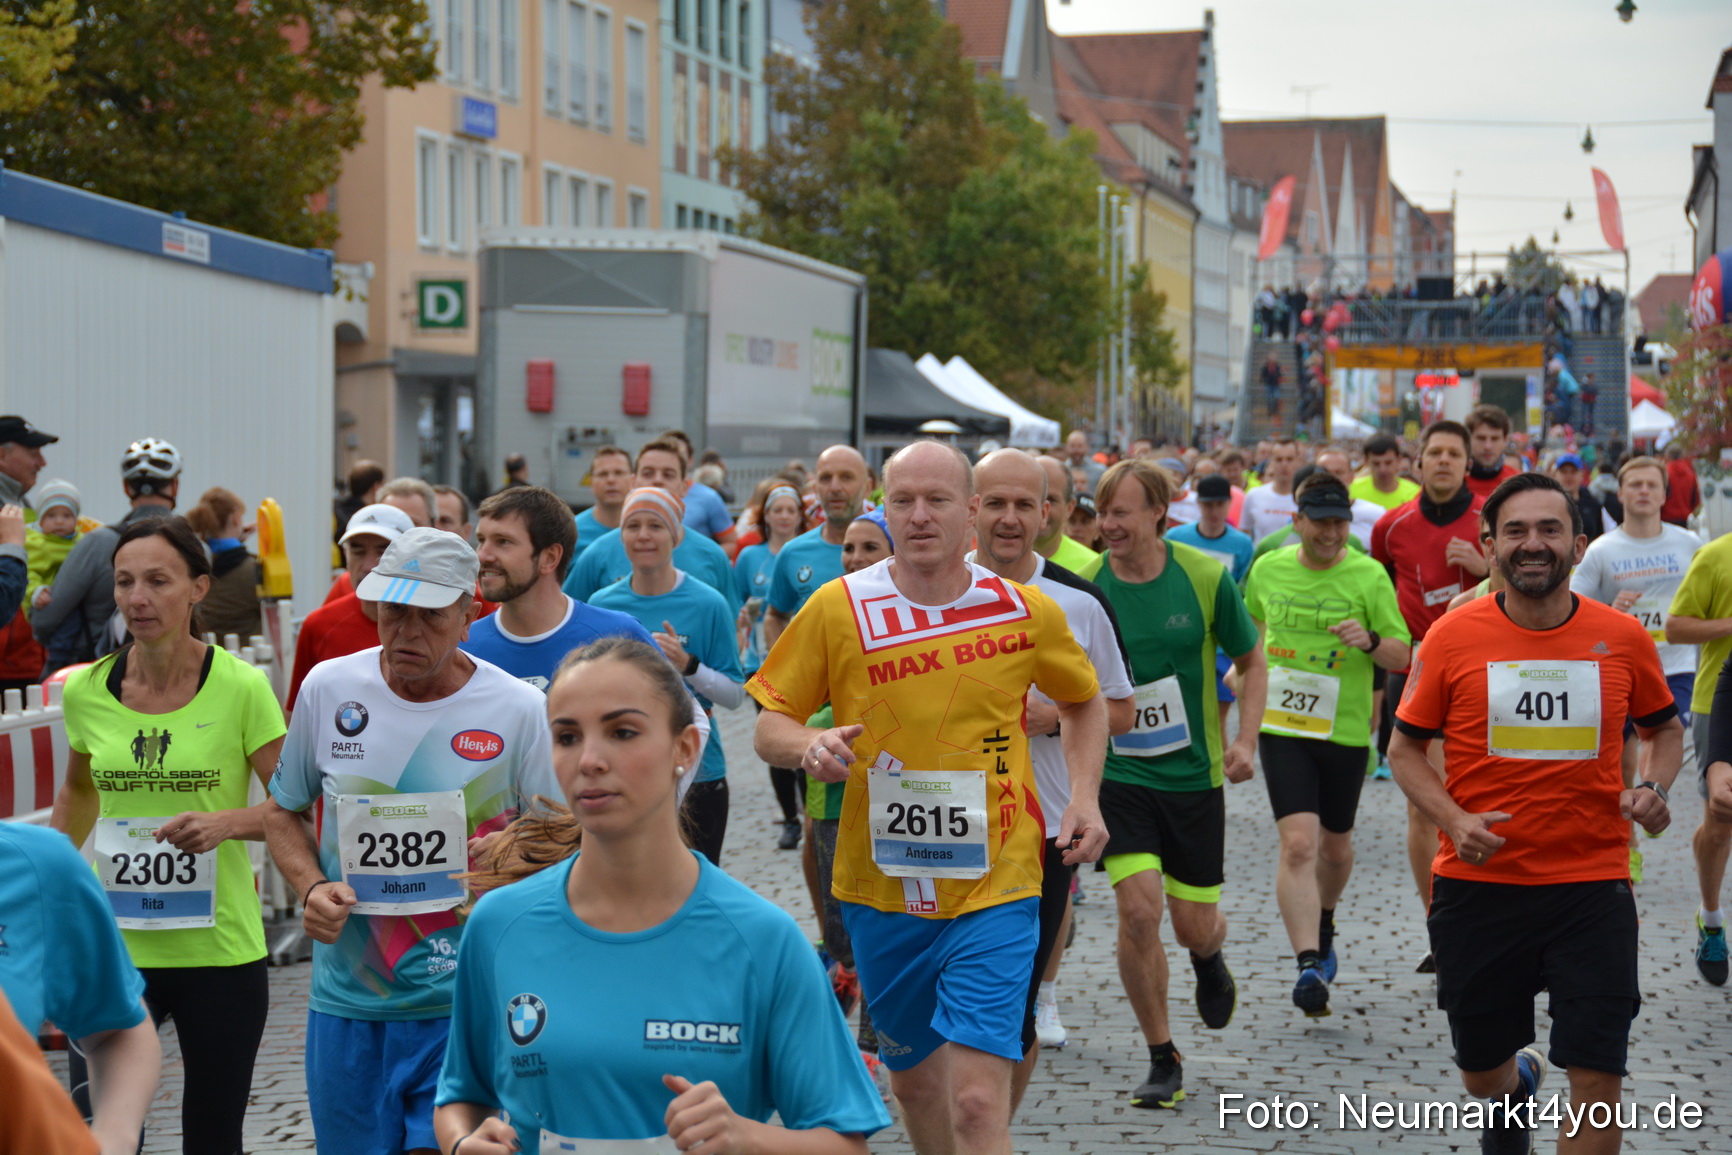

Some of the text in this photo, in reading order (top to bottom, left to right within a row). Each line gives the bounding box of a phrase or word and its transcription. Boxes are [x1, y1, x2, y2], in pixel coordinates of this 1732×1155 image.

[424, 286, 461, 323] D
[1611, 553, 1676, 572] VR BANK
[1634, 611, 1662, 627] 74
[867, 632, 1035, 686] MAX BÖGL
[1529, 669, 1568, 678] BOCK
[1281, 689, 1320, 712] 237
[1515, 691, 1569, 721] 401
[1134, 702, 1170, 728] 761
[331, 742, 365, 752] PARTL
[458, 735, 499, 754] Hervis
[331, 752, 364, 760] Neumarkt
[911, 780, 952, 791] BOCK
[382, 804, 428, 817] BOCK
[886, 802, 969, 837] 2615
[357, 830, 447, 868] 2382
[905, 847, 953, 860] Andreas
[111, 851, 197, 886] 2303
[381, 880, 426, 894] Johann
[142, 897, 164, 910] Rita
[429, 937, 457, 956] 16.
[645, 1020, 740, 1045] BOCK
[643, 1043, 675, 1052] inspired
[677, 1044, 687, 1052] by
[690, 1045, 712, 1053] smart
[511, 1053, 547, 1068] PARTL
